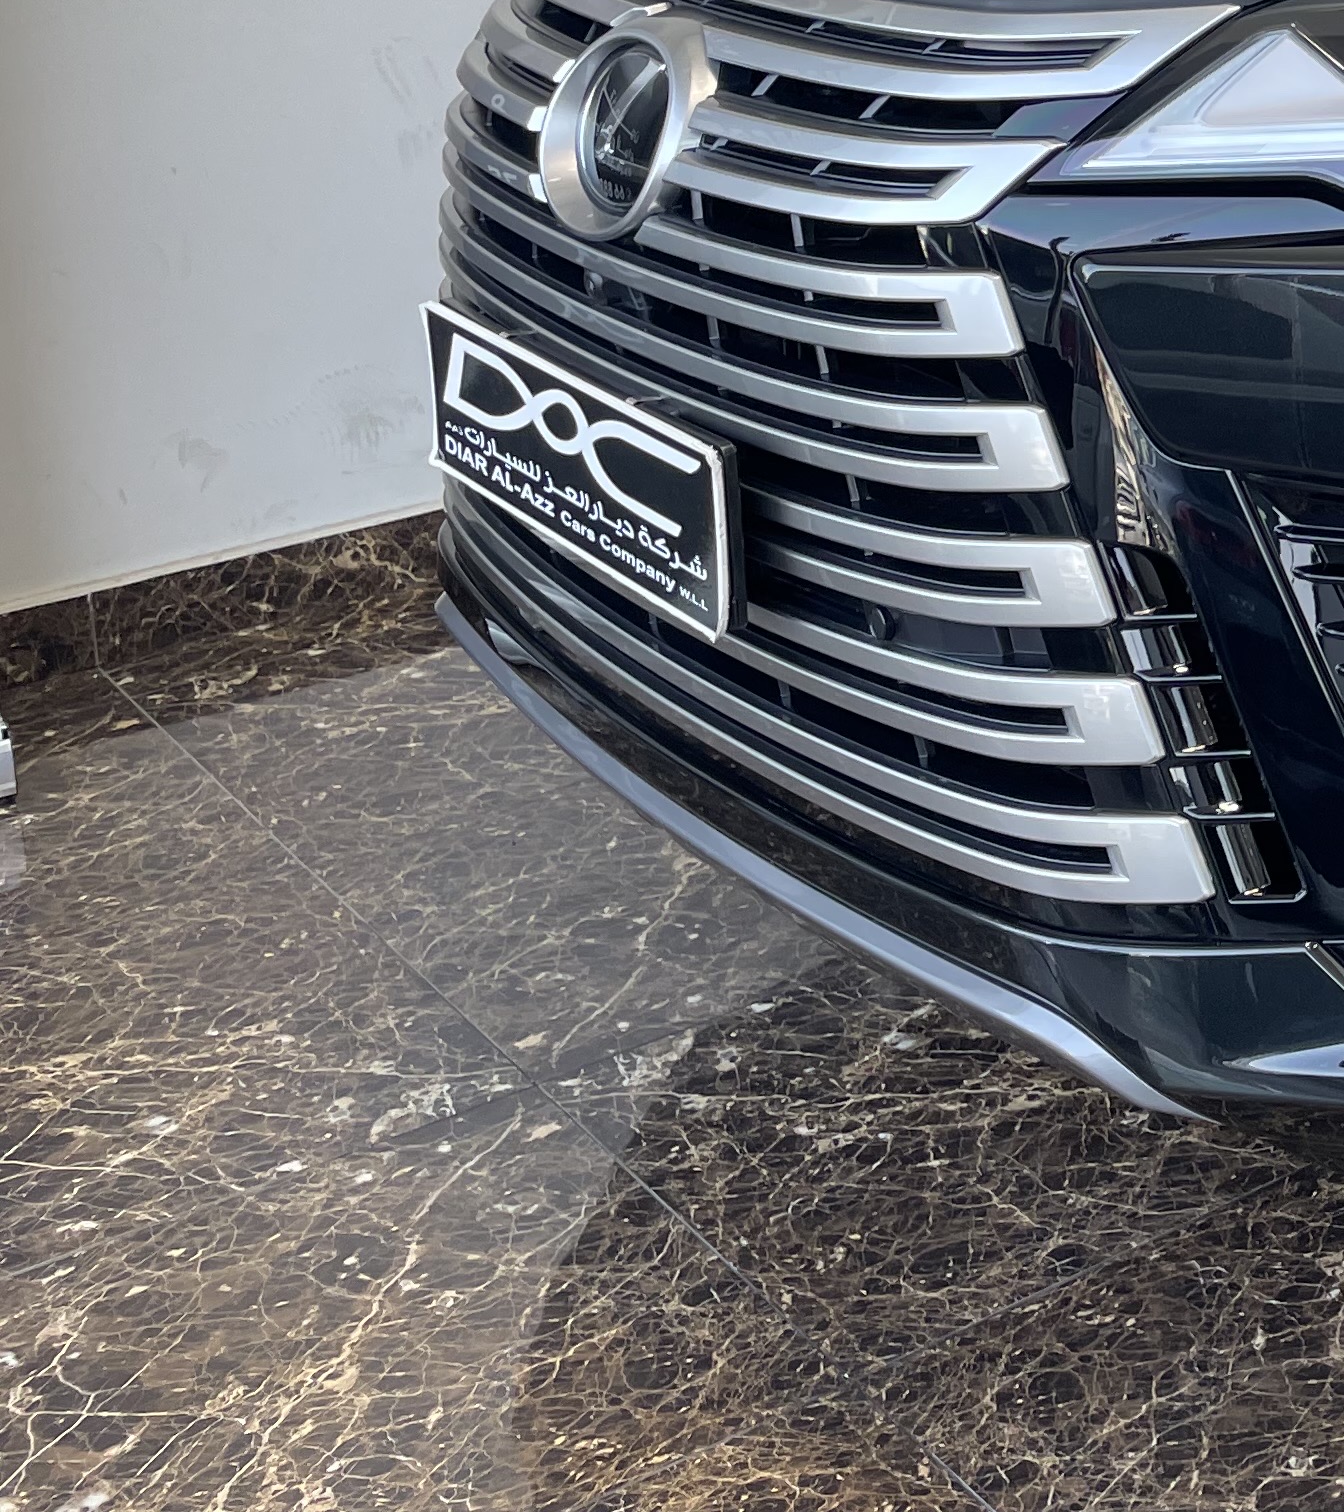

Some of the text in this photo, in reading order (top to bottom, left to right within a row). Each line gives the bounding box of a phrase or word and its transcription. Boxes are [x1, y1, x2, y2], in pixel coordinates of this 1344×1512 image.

[464, 426, 541, 482] للسيارات
[445, 433, 488, 477] DIAR
[560, 510, 596, 543] Cars
[599, 533, 676, 593] Company
[543, 470, 590, 512] العز
[588, 501, 635, 539] ديار
[638, 524, 708, 581] شركة
